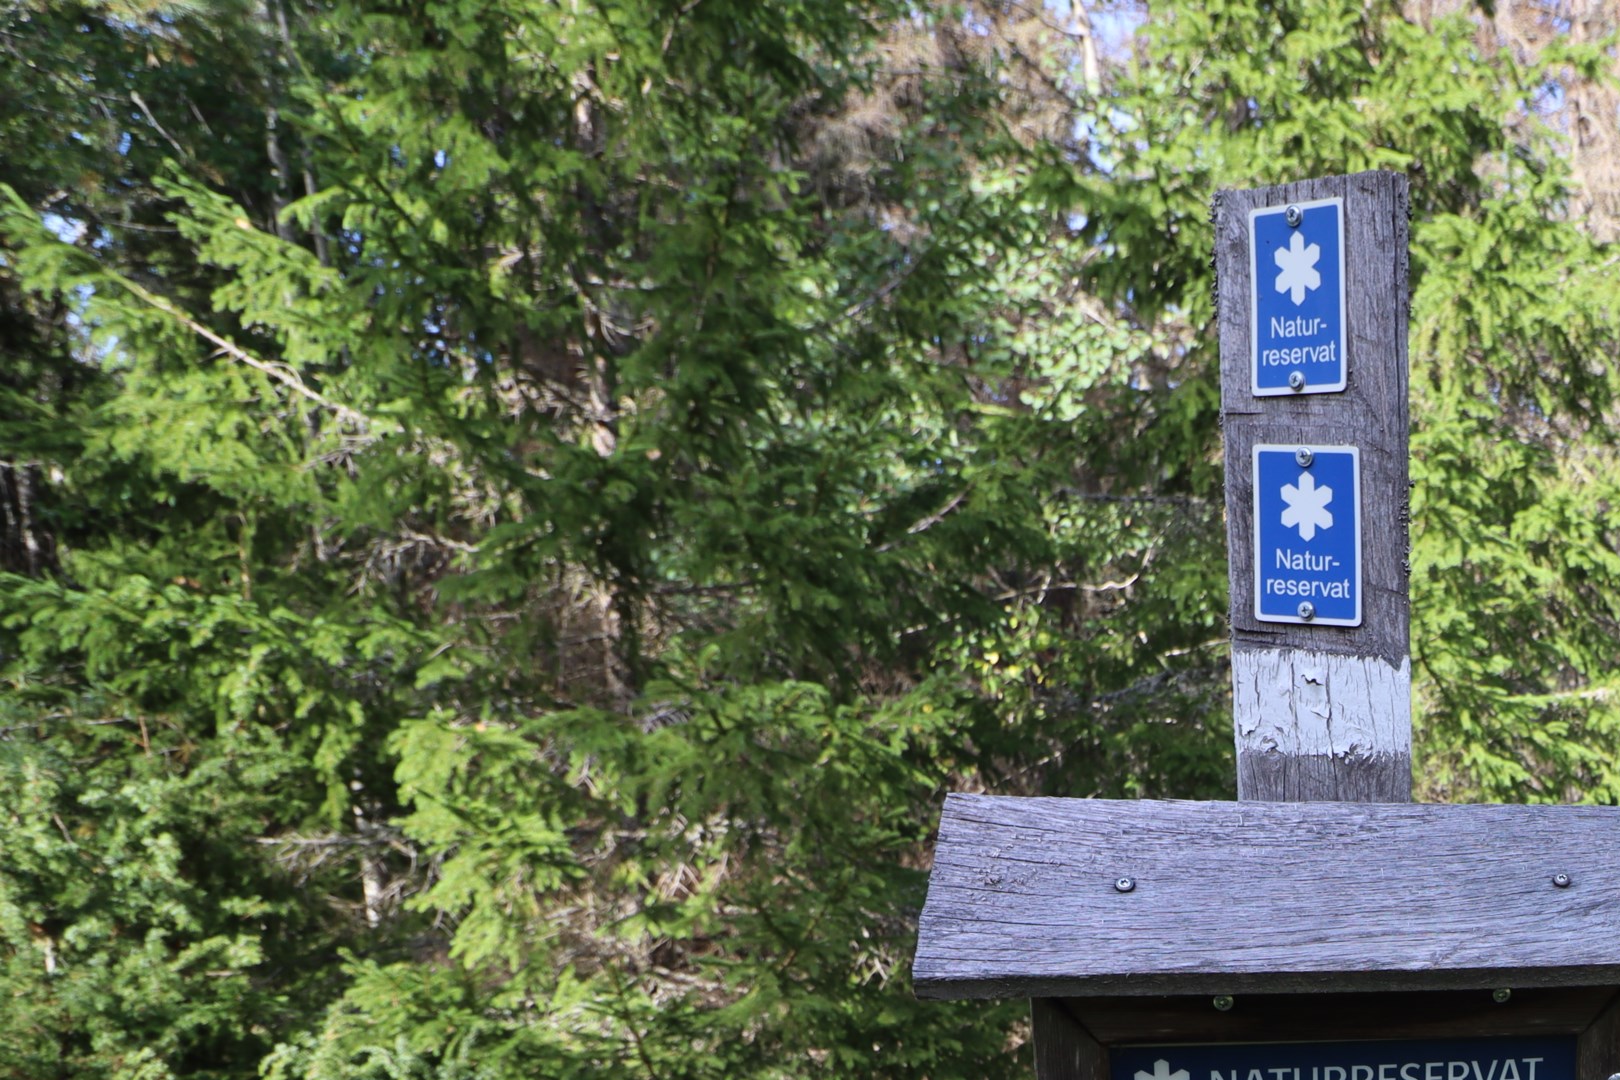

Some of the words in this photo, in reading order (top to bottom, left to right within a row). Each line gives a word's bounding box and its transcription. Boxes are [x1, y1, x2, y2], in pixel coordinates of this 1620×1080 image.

[1271, 315, 1327, 339] Natur-
[1262, 340, 1336, 367] reservat
[1275, 548, 1340, 572] Natur-
[1266, 578, 1350, 599] reservat
